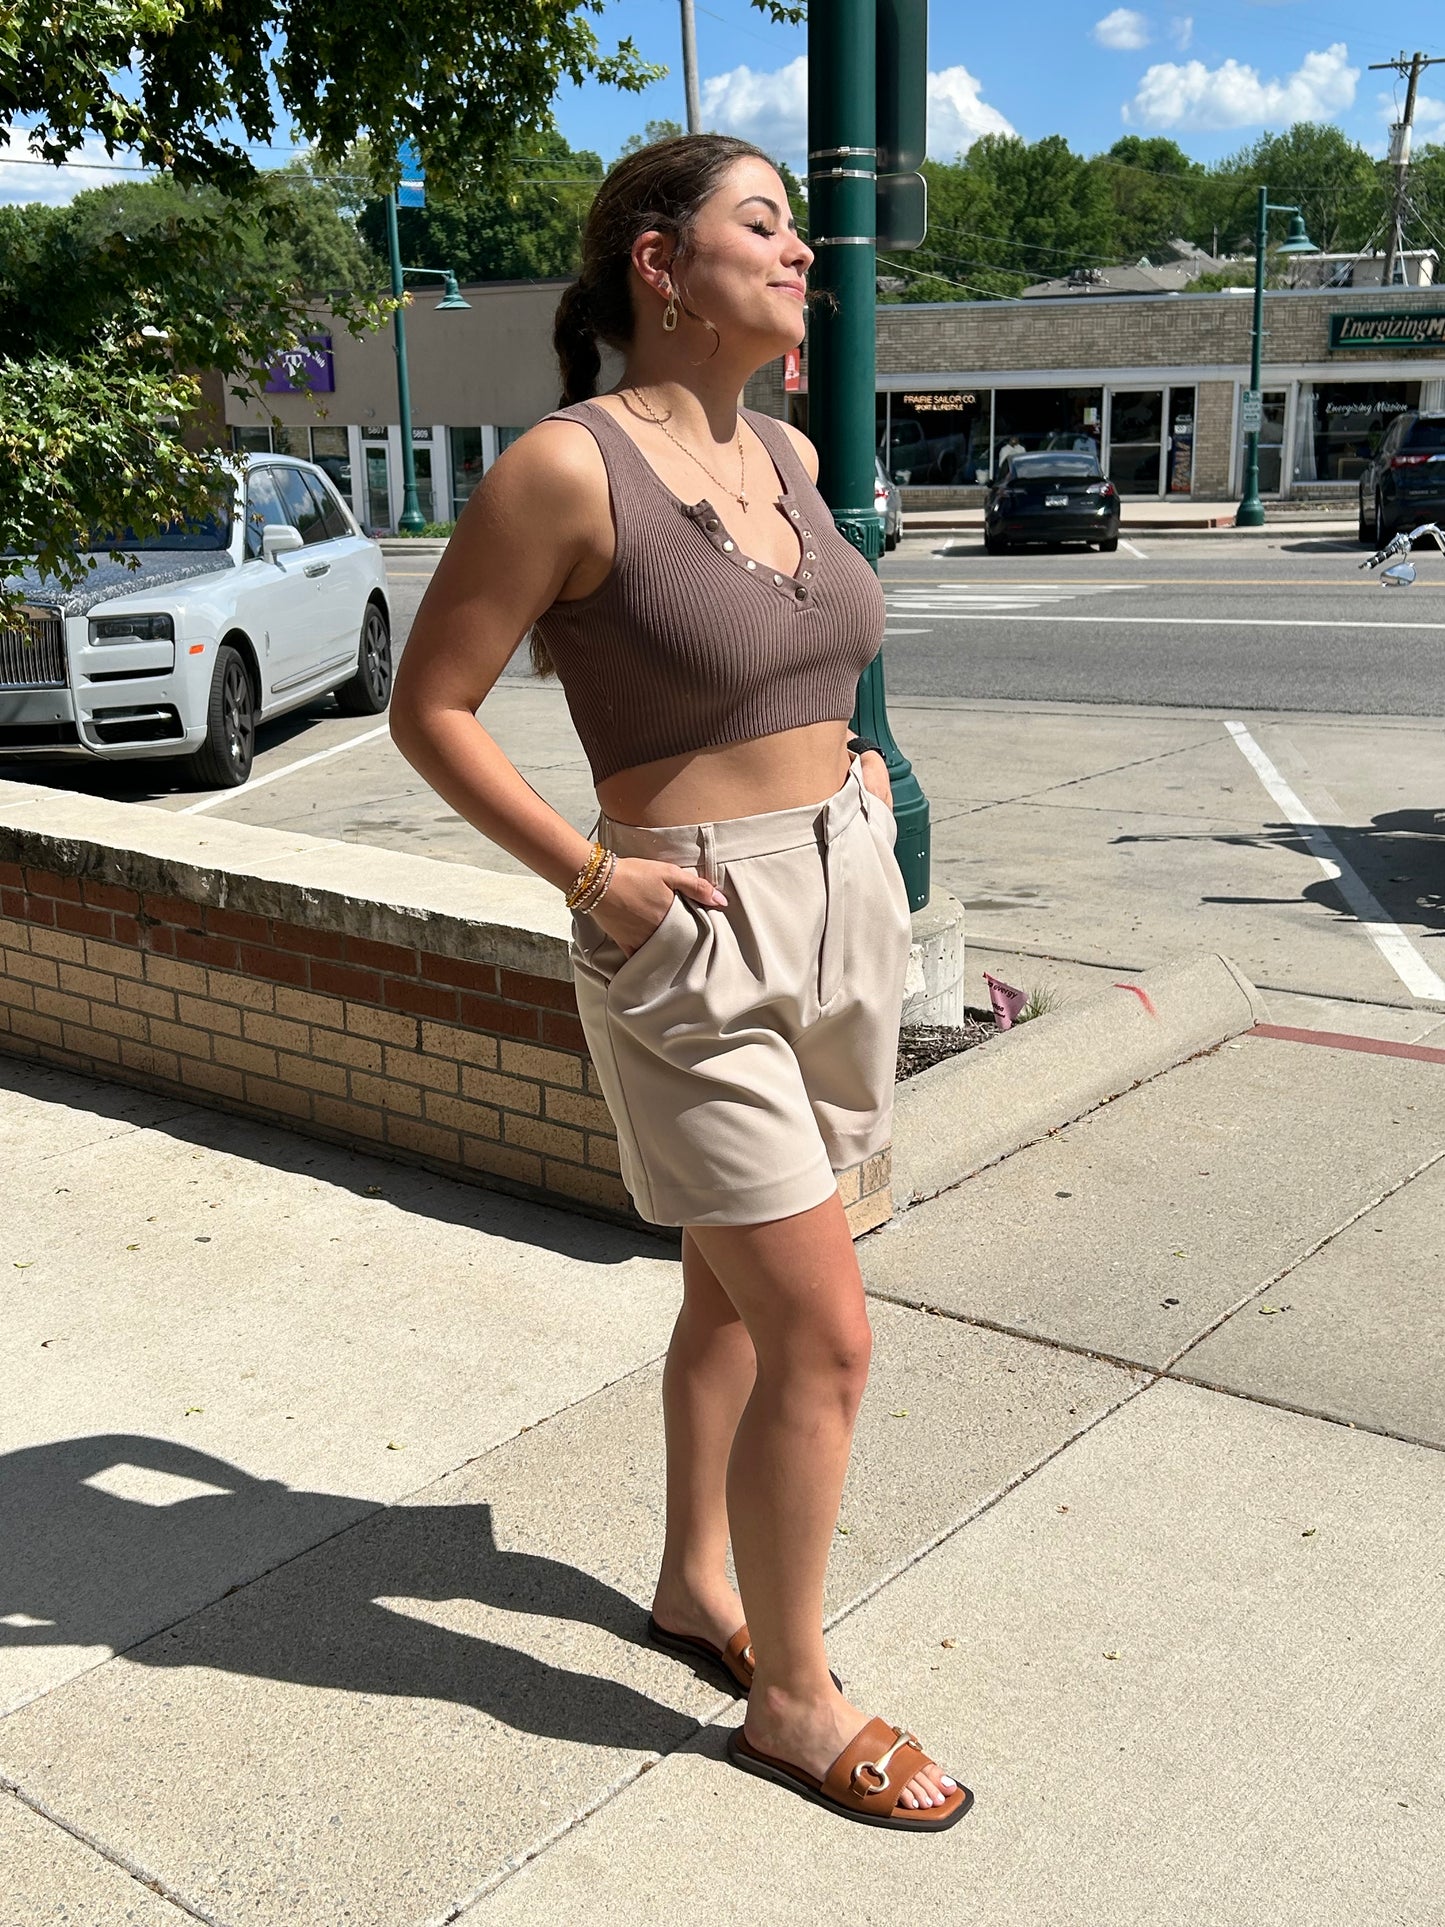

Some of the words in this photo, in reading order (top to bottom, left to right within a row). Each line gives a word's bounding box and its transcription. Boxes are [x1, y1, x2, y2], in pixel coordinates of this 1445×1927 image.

[933, 395, 962, 404] SAILOR
[1325, 402, 1372, 417] Energizing
[1373, 401, 1408, 413] Mission
